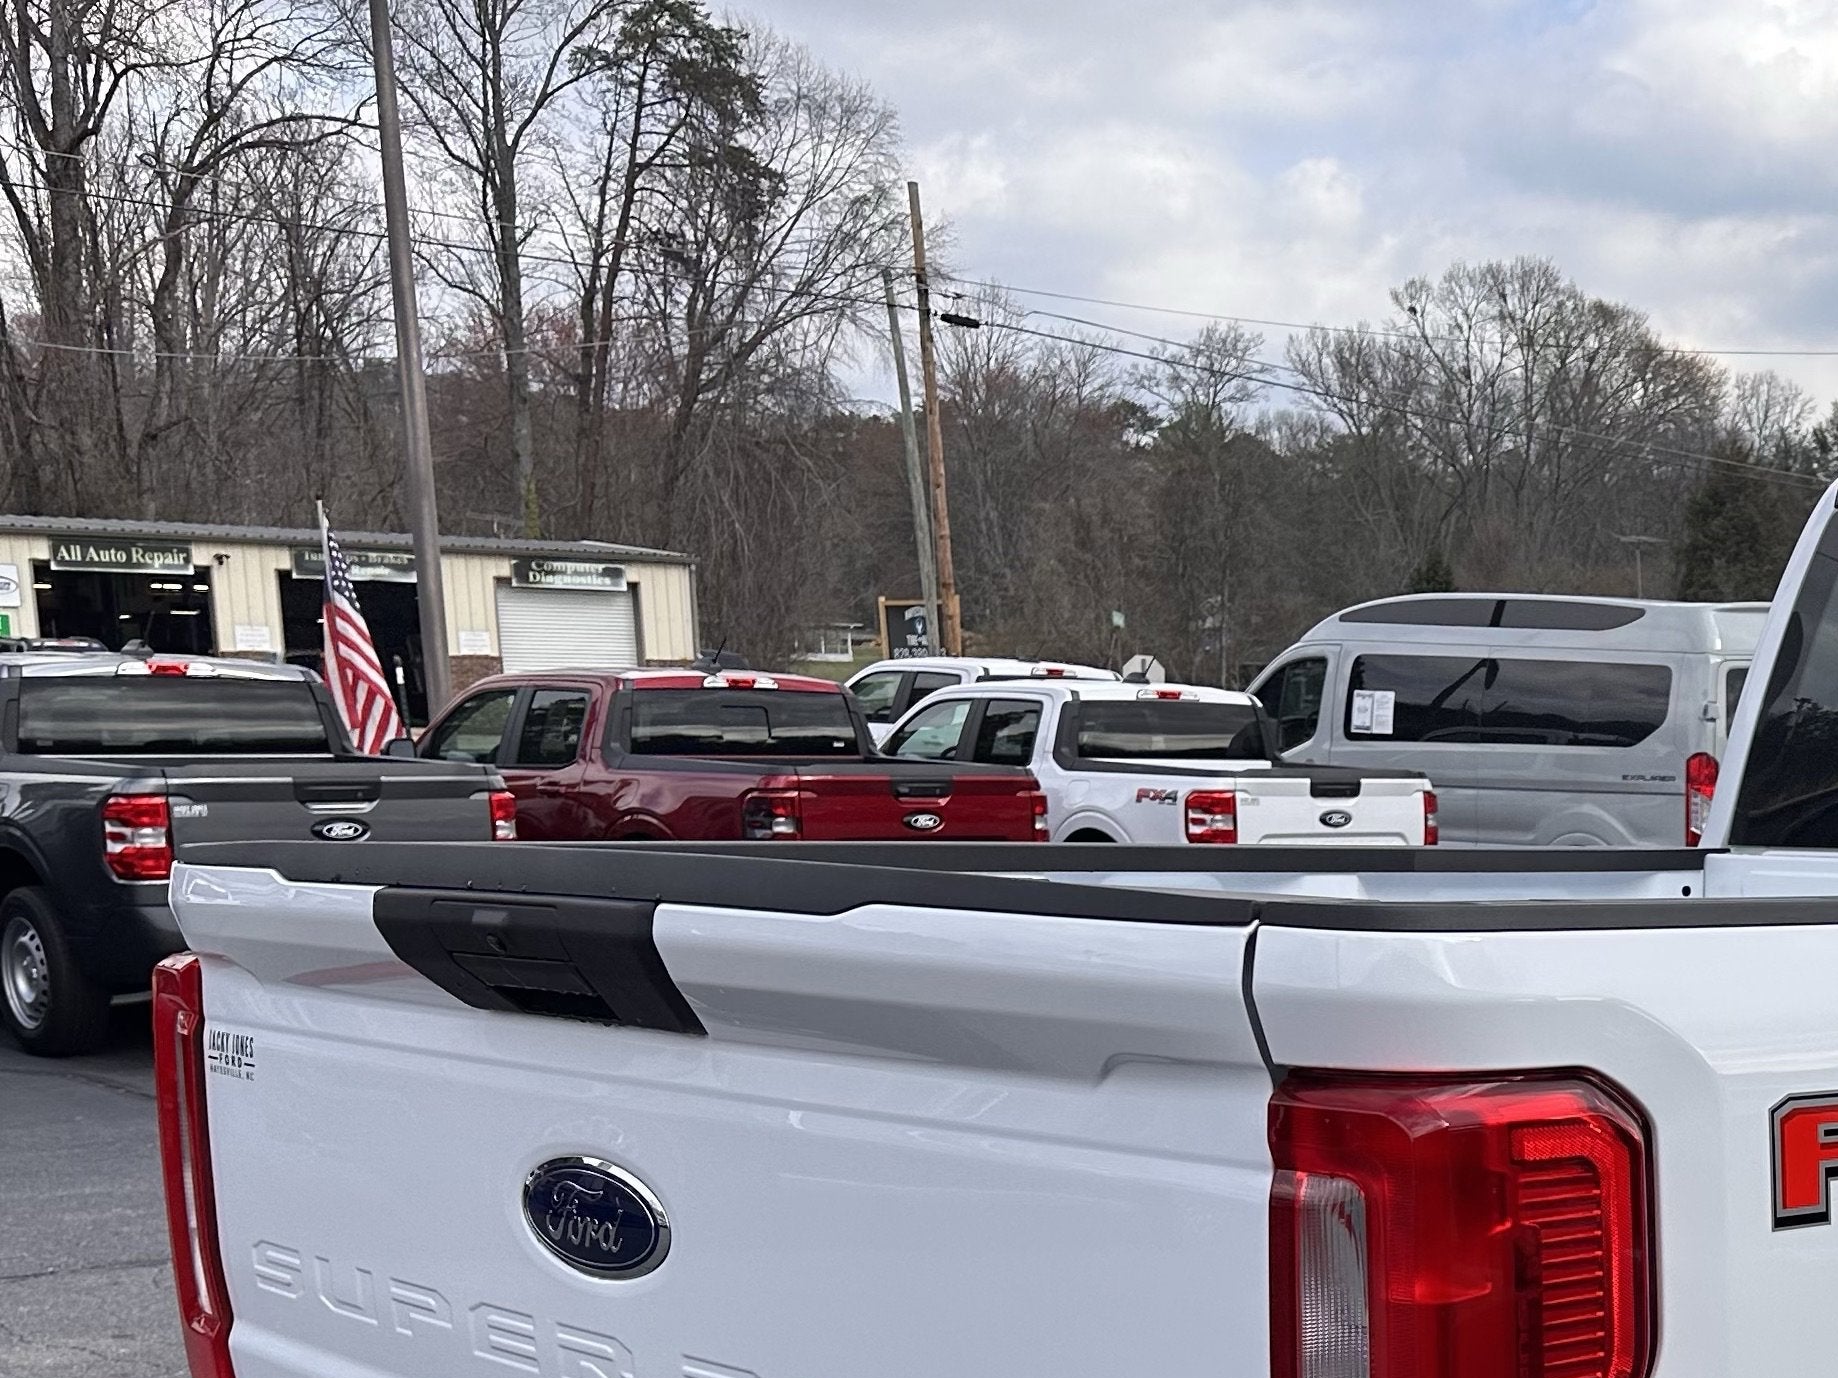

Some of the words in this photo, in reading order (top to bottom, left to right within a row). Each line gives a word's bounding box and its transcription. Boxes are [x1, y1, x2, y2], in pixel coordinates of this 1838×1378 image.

[56, 544, 82, 562] All
[85, 545, 127, 564] Auto
[131, 547, 187, 568] Repair
[530, 560, 603, 574] Computer
[528, 571, 612, 585] Diagnostics
[1135, 787, 1179, 804] FX4
[208, 1029, 231, 1053] JACKY
[231, 1033, 254, 1059] JONES
[219, 1052, 242, 1069] FORD
[545, 1180, 623, 1253] Ford
